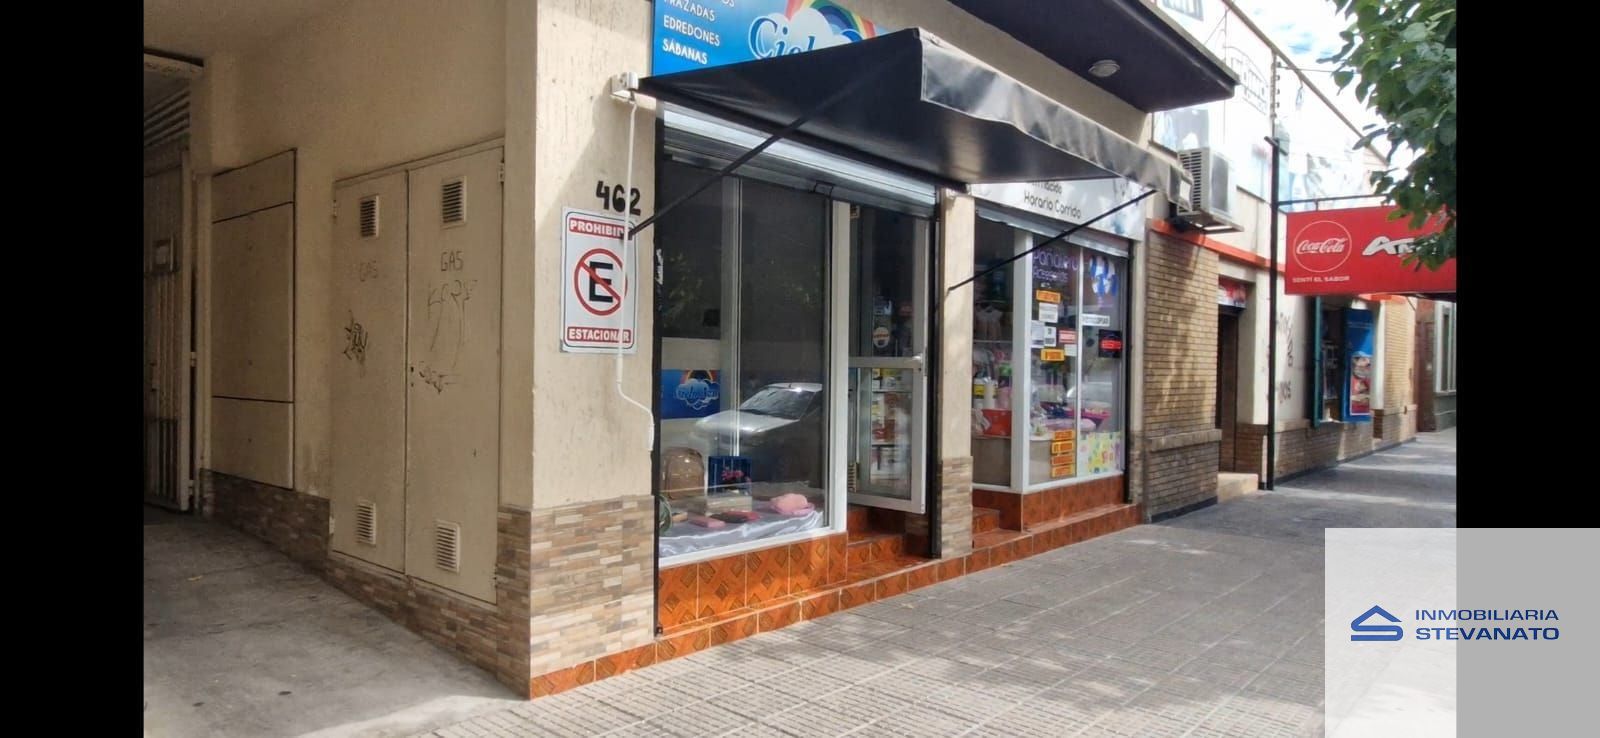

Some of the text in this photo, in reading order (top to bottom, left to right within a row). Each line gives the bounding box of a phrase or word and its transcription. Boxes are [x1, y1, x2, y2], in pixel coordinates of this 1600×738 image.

[664, 0, 716, 22] RAZADAS
[663, 15, 720, 47] EDREDONES
[662, 37, 708, 65] SÁBANAS
[595, 180, 641, 217] 462
[1024, 191, 1082, 219] Horario Corrido
[569, 218, 627, 240] PROHIBID
[1296, 236, 1349, 255] Coca-Cola
[440, 250, 464, 272] GAS
